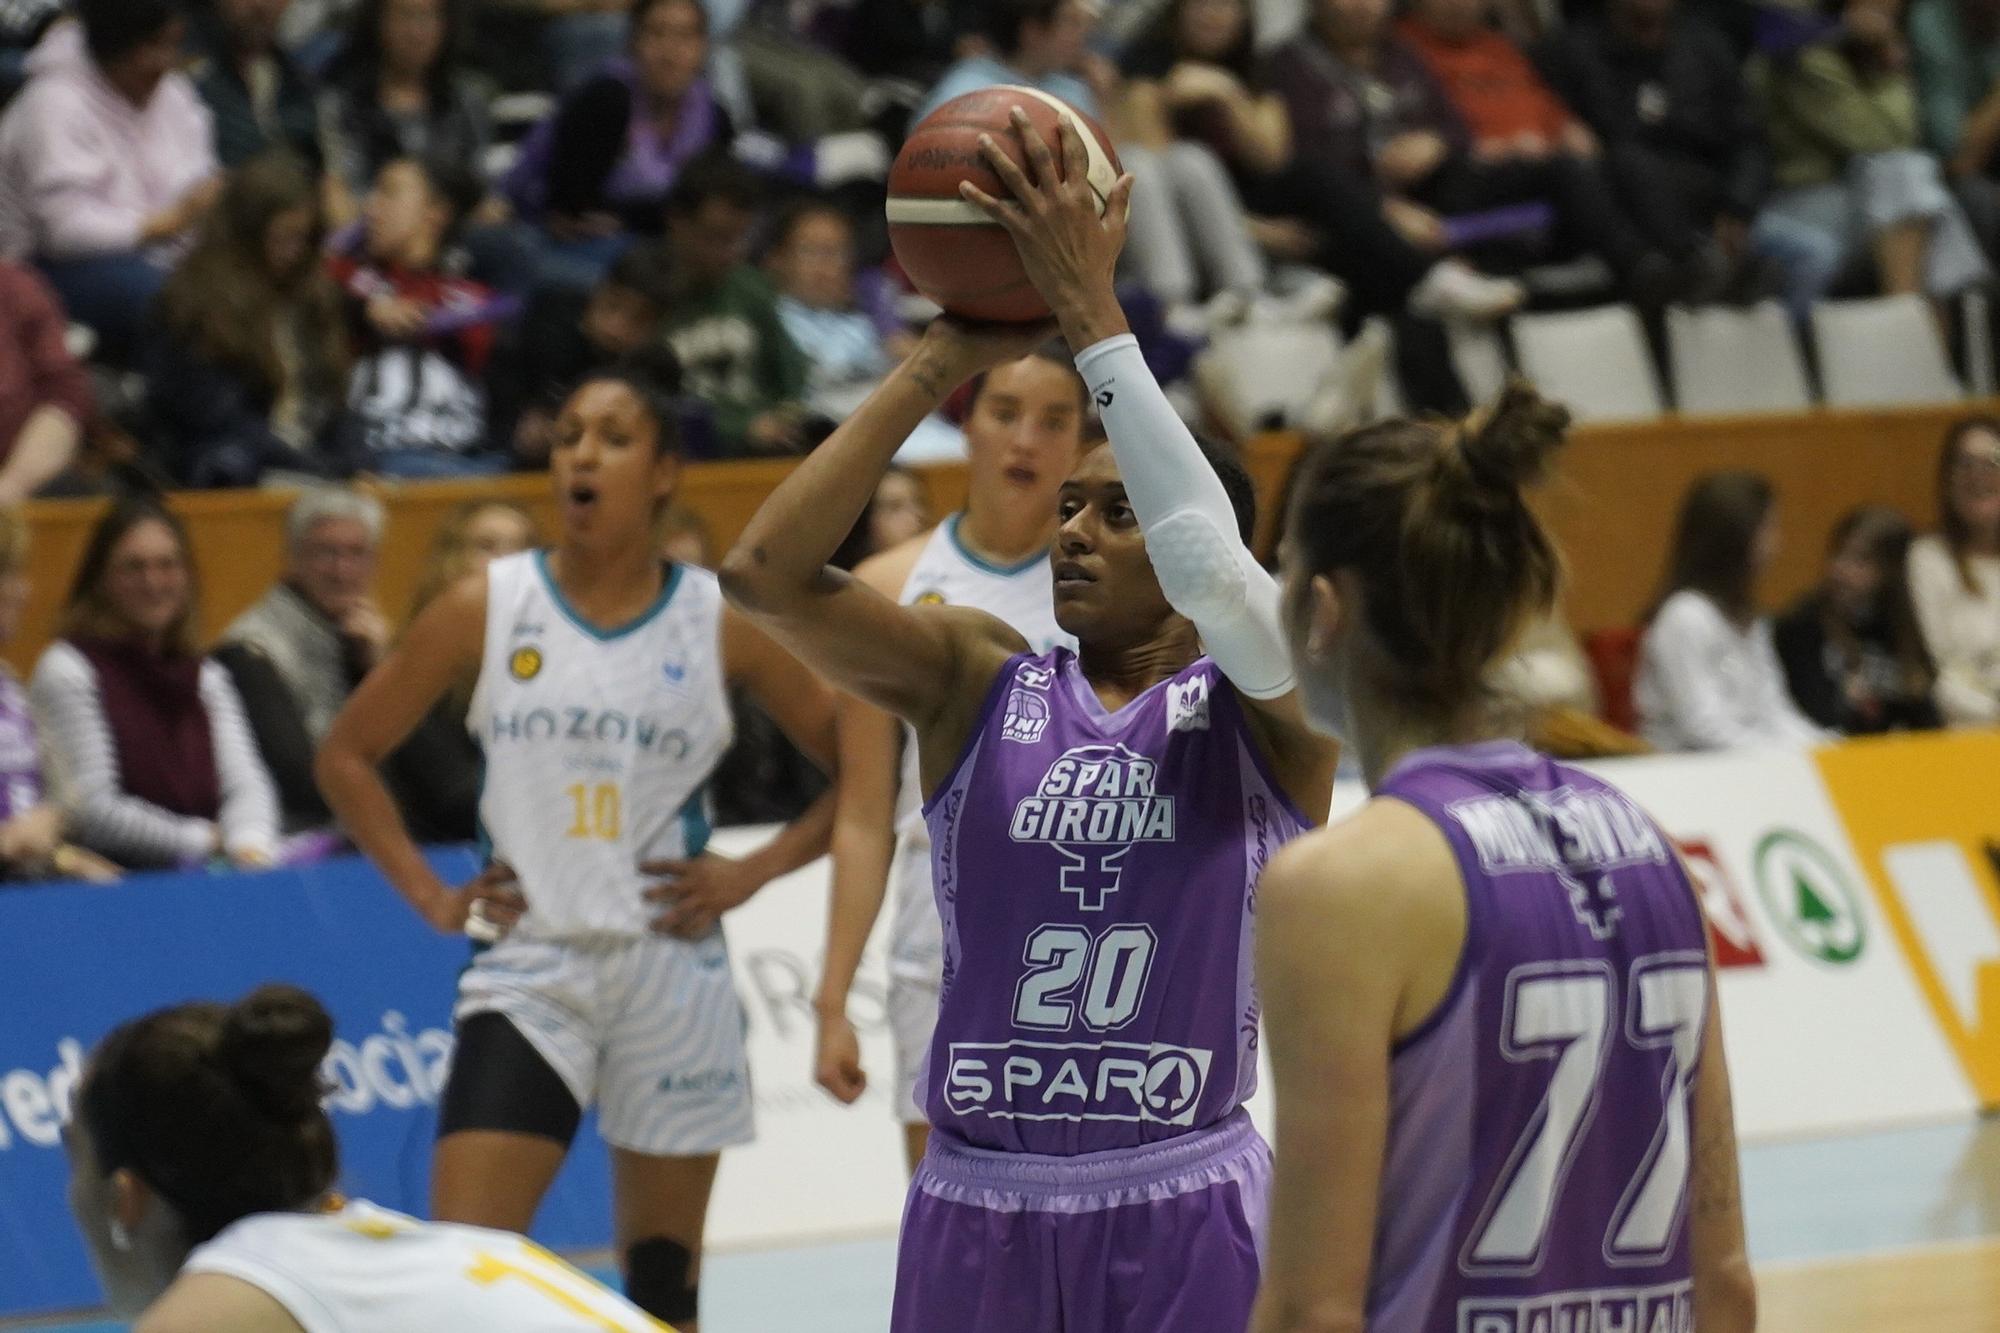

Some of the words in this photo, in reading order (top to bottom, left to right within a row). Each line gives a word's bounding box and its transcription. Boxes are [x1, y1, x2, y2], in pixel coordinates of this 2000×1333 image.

[1002, 728, 1040, 741] IRONA
[1044, 758, 1154, 797] SPAR
[563, 780, 622, 841] 10
[1010, 799, 1174, 842] GIRONA
[1012, 923, 1157, 1031] 20
[0, 1037, 83, 1150] ed
[320, 1010, 456, 1114] ocia
[950, 1055, 1150, 1105] SPAR
[1460, 952, 1708, 1275] 77
